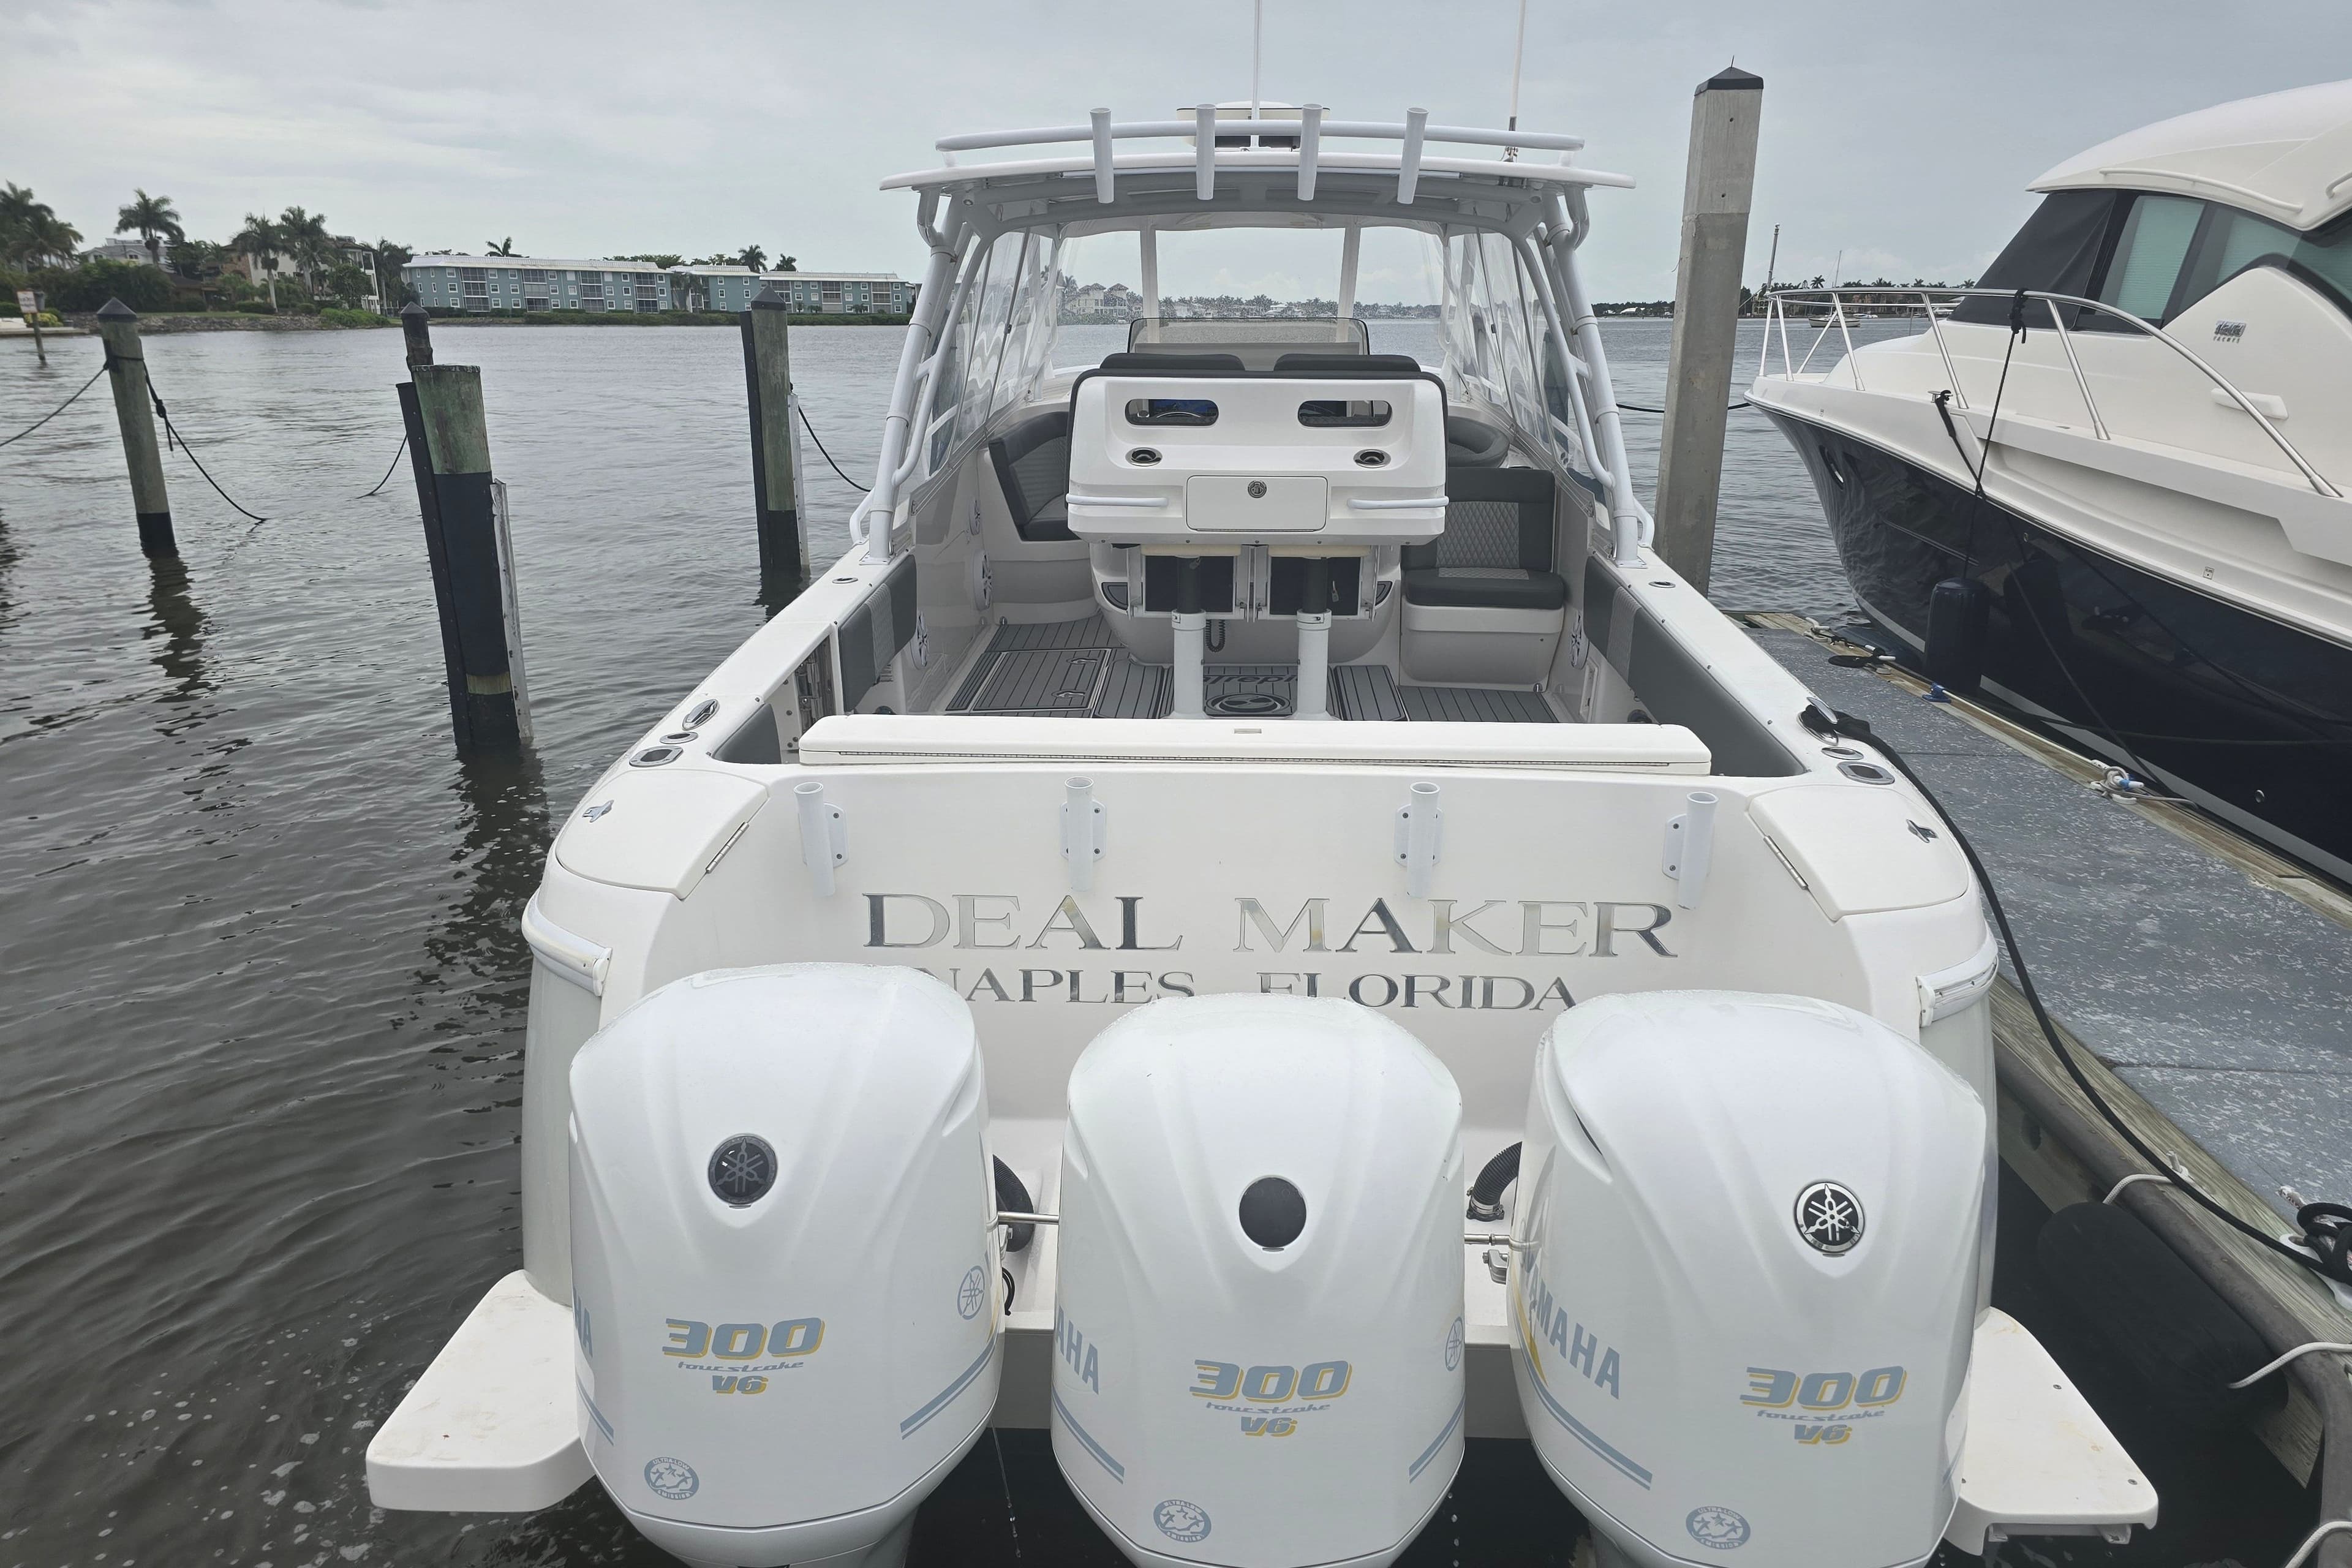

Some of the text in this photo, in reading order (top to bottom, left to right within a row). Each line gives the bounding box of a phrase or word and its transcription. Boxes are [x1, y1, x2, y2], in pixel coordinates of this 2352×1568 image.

[862, 892, 1678, 958] DEAL MAKER
[662, 1317, 826, 1360] 300
[1055, 1304, 1099, 1396] AHA
[712, 1374, 769, 1395] V6
[1189, 1359, 1353, 1404] 300
[1739, 1365, 1907, 1411] 300
[1240, 1415, 1298, 1438] V6
[1793, 1423, 1853, 1445] V6
